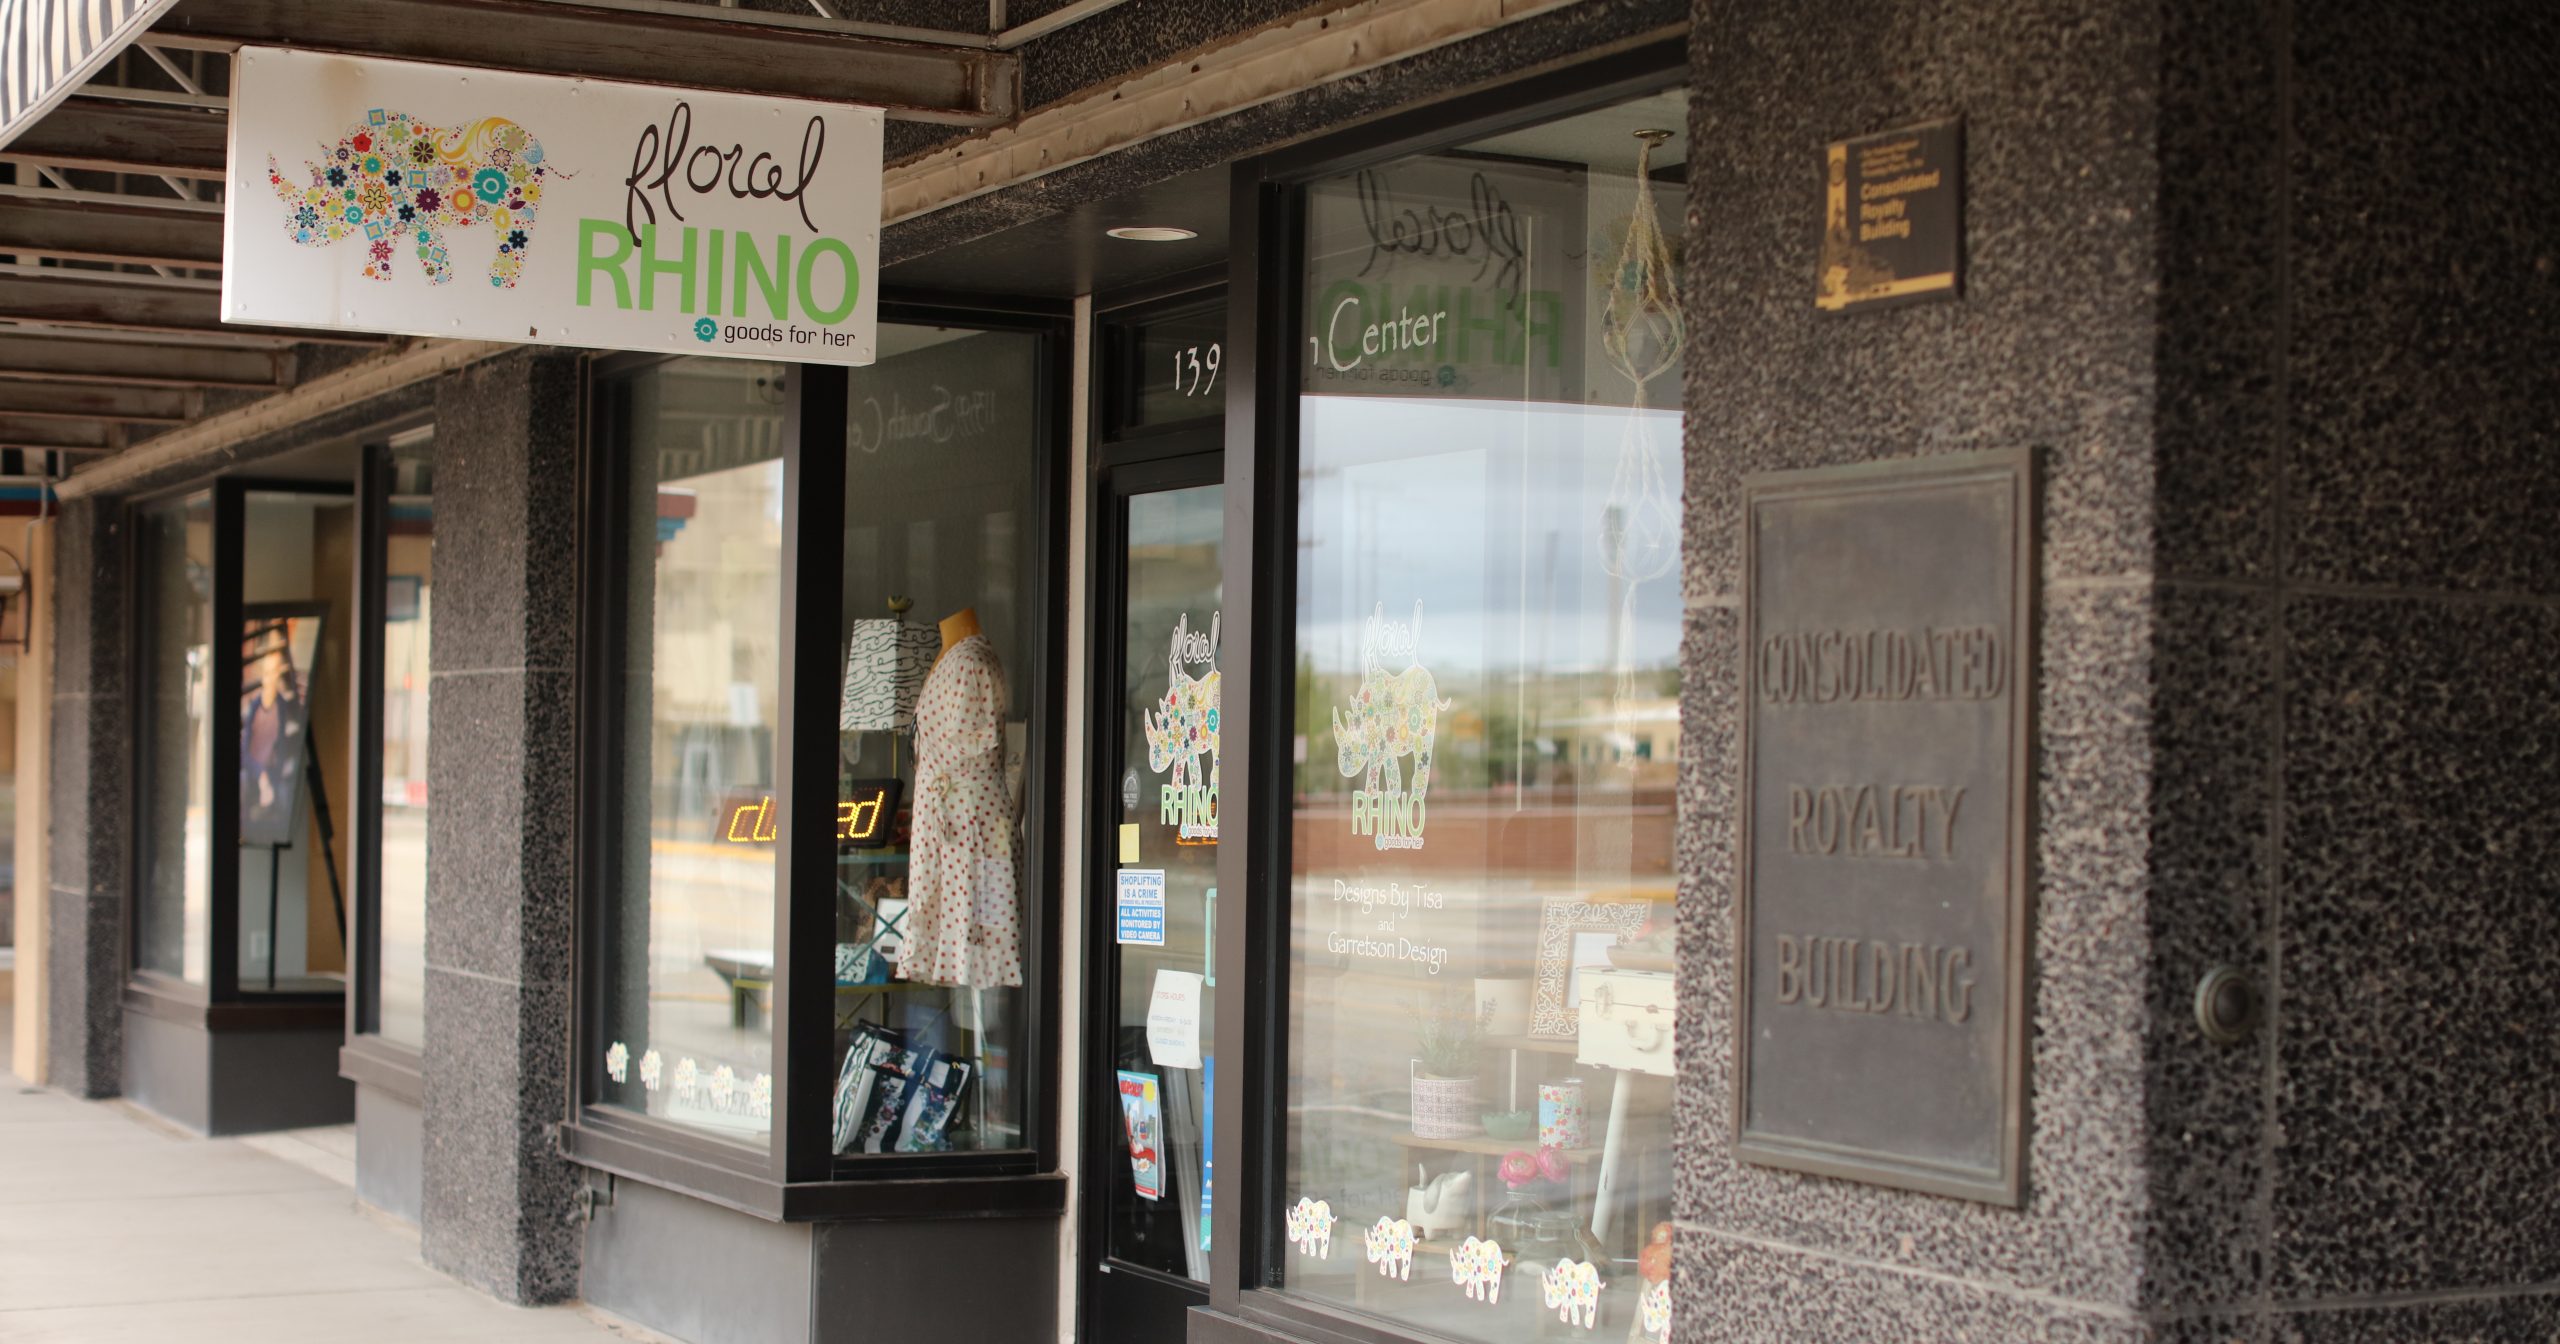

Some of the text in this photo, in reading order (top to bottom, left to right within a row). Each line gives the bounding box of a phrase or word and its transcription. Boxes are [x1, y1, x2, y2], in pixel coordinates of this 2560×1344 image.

[625, 102, 825, 248] floral
[1861, 170, 1940, 201] Consolidated
[1860, 219, 1910, 242] Building
[575, 218, 861, 325] RHINO
[724, 323, 855, 347] goods for her
[1328, 297, 1446, 372] Center
[1175, 343, 1220, 397] 139
[1169, 610, 1220, 688] floral
[1762, 623, 2003, 705] CONSOLIDATED
[1161, 784, 1219, 827] RHINO
[1352, 790, 1425, 837] RHINO
[1788, 784, 1968, 860] ROYALTY
[1120, 876, 1162, 886] SHOPLIFTING
[1125, 889, 1158, 899] IS A CRIME
[1334, 879, 1443, 919] Designs By Tisa
[1121, 907, 1161, 918] ALL ACTIVITIES
[1121, 919, 1161, 930] MONITORED BY
[1378, 911, 1395, 931] and
[1121, 930, 1161, 940] VIDEO CAMERA
[1328, 931, 1447, 974] Garretson Design
[1776, 934, 1976, 1025] BUILDING
